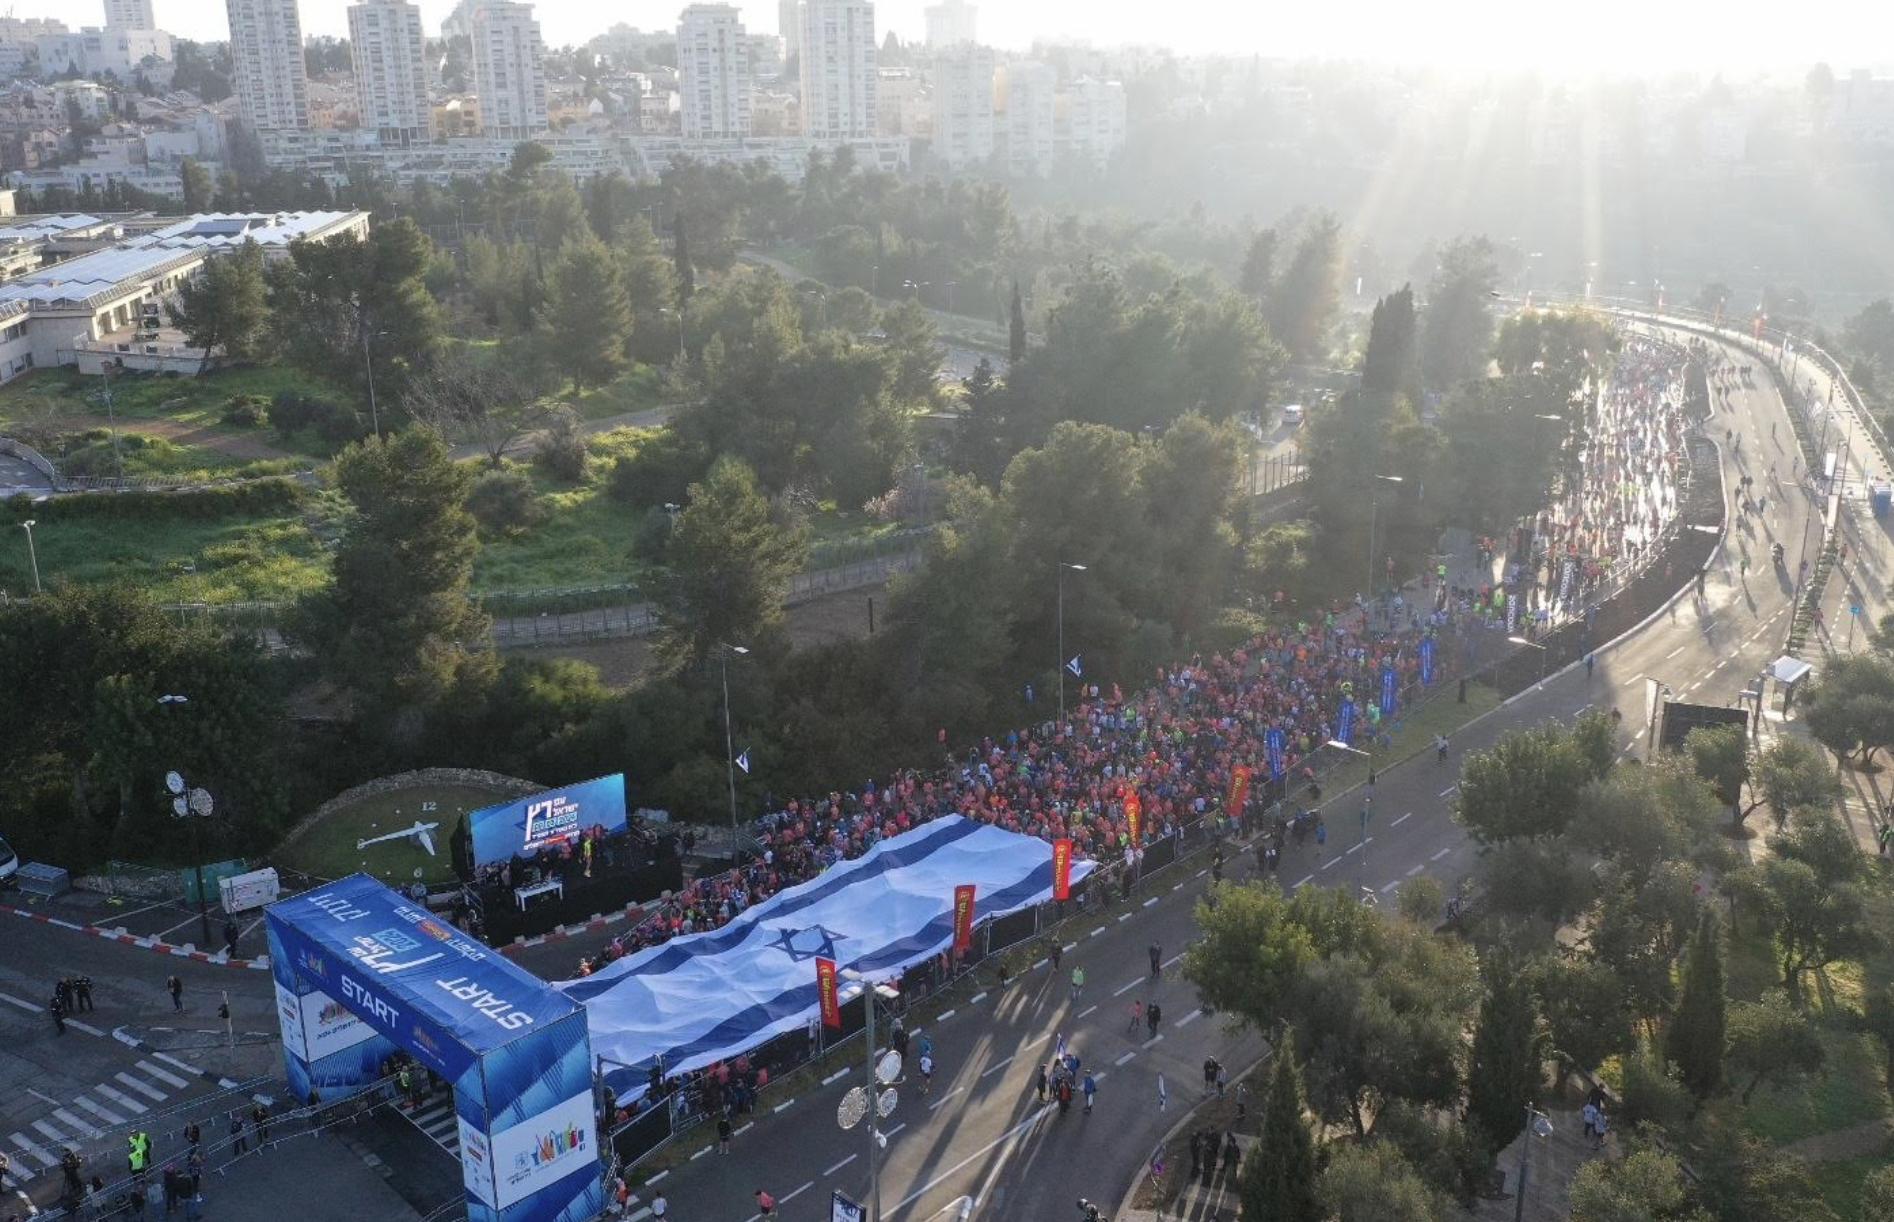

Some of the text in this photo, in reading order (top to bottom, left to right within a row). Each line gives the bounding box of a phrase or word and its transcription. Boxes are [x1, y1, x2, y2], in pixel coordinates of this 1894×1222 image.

[422, 801, 437, 811] 12
[308, 893, 371, 923] זינוק
[341, 975, 400, 1029] START
[436, 977, 534, 1030] START
